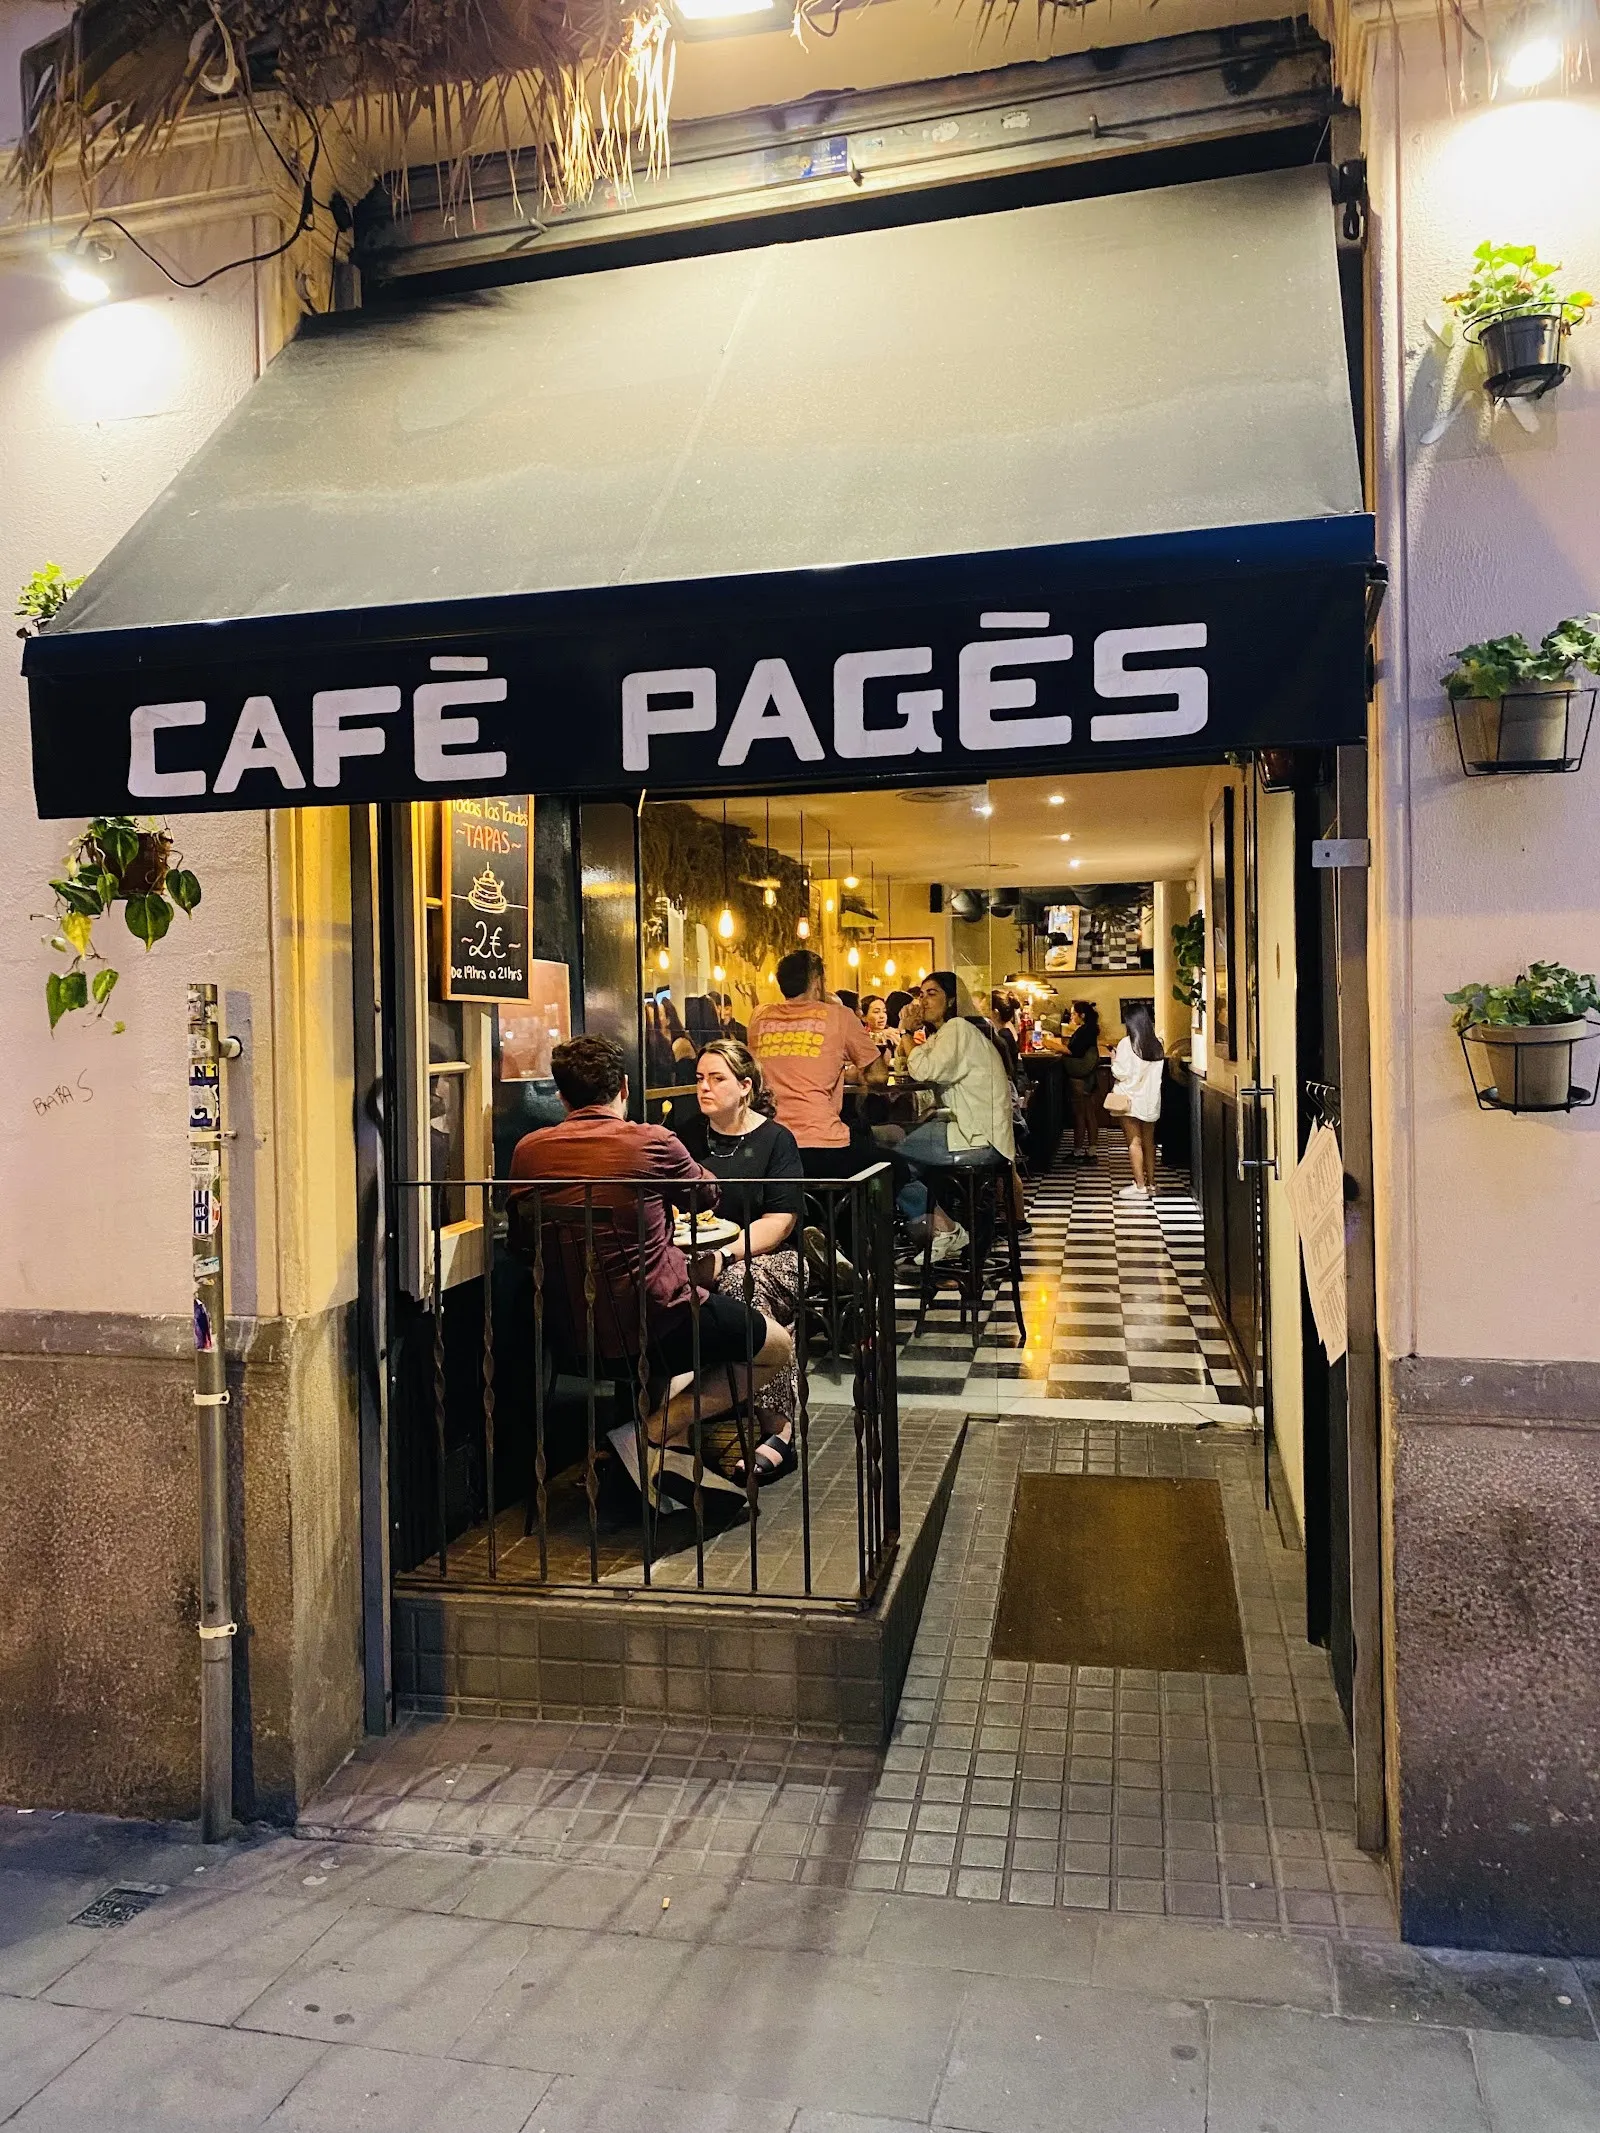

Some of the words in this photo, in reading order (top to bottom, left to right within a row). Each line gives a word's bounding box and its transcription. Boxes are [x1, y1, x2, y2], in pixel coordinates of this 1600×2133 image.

[462, 822, 511, 854] TAPAS
[468, 920, 507, 959] 2€
[451, 966, 463, 979] De
[463, 965, 487, 980] 19hrs
[488, 969, 497, 980] a
[497, 965, 523, 981] 21hrs
